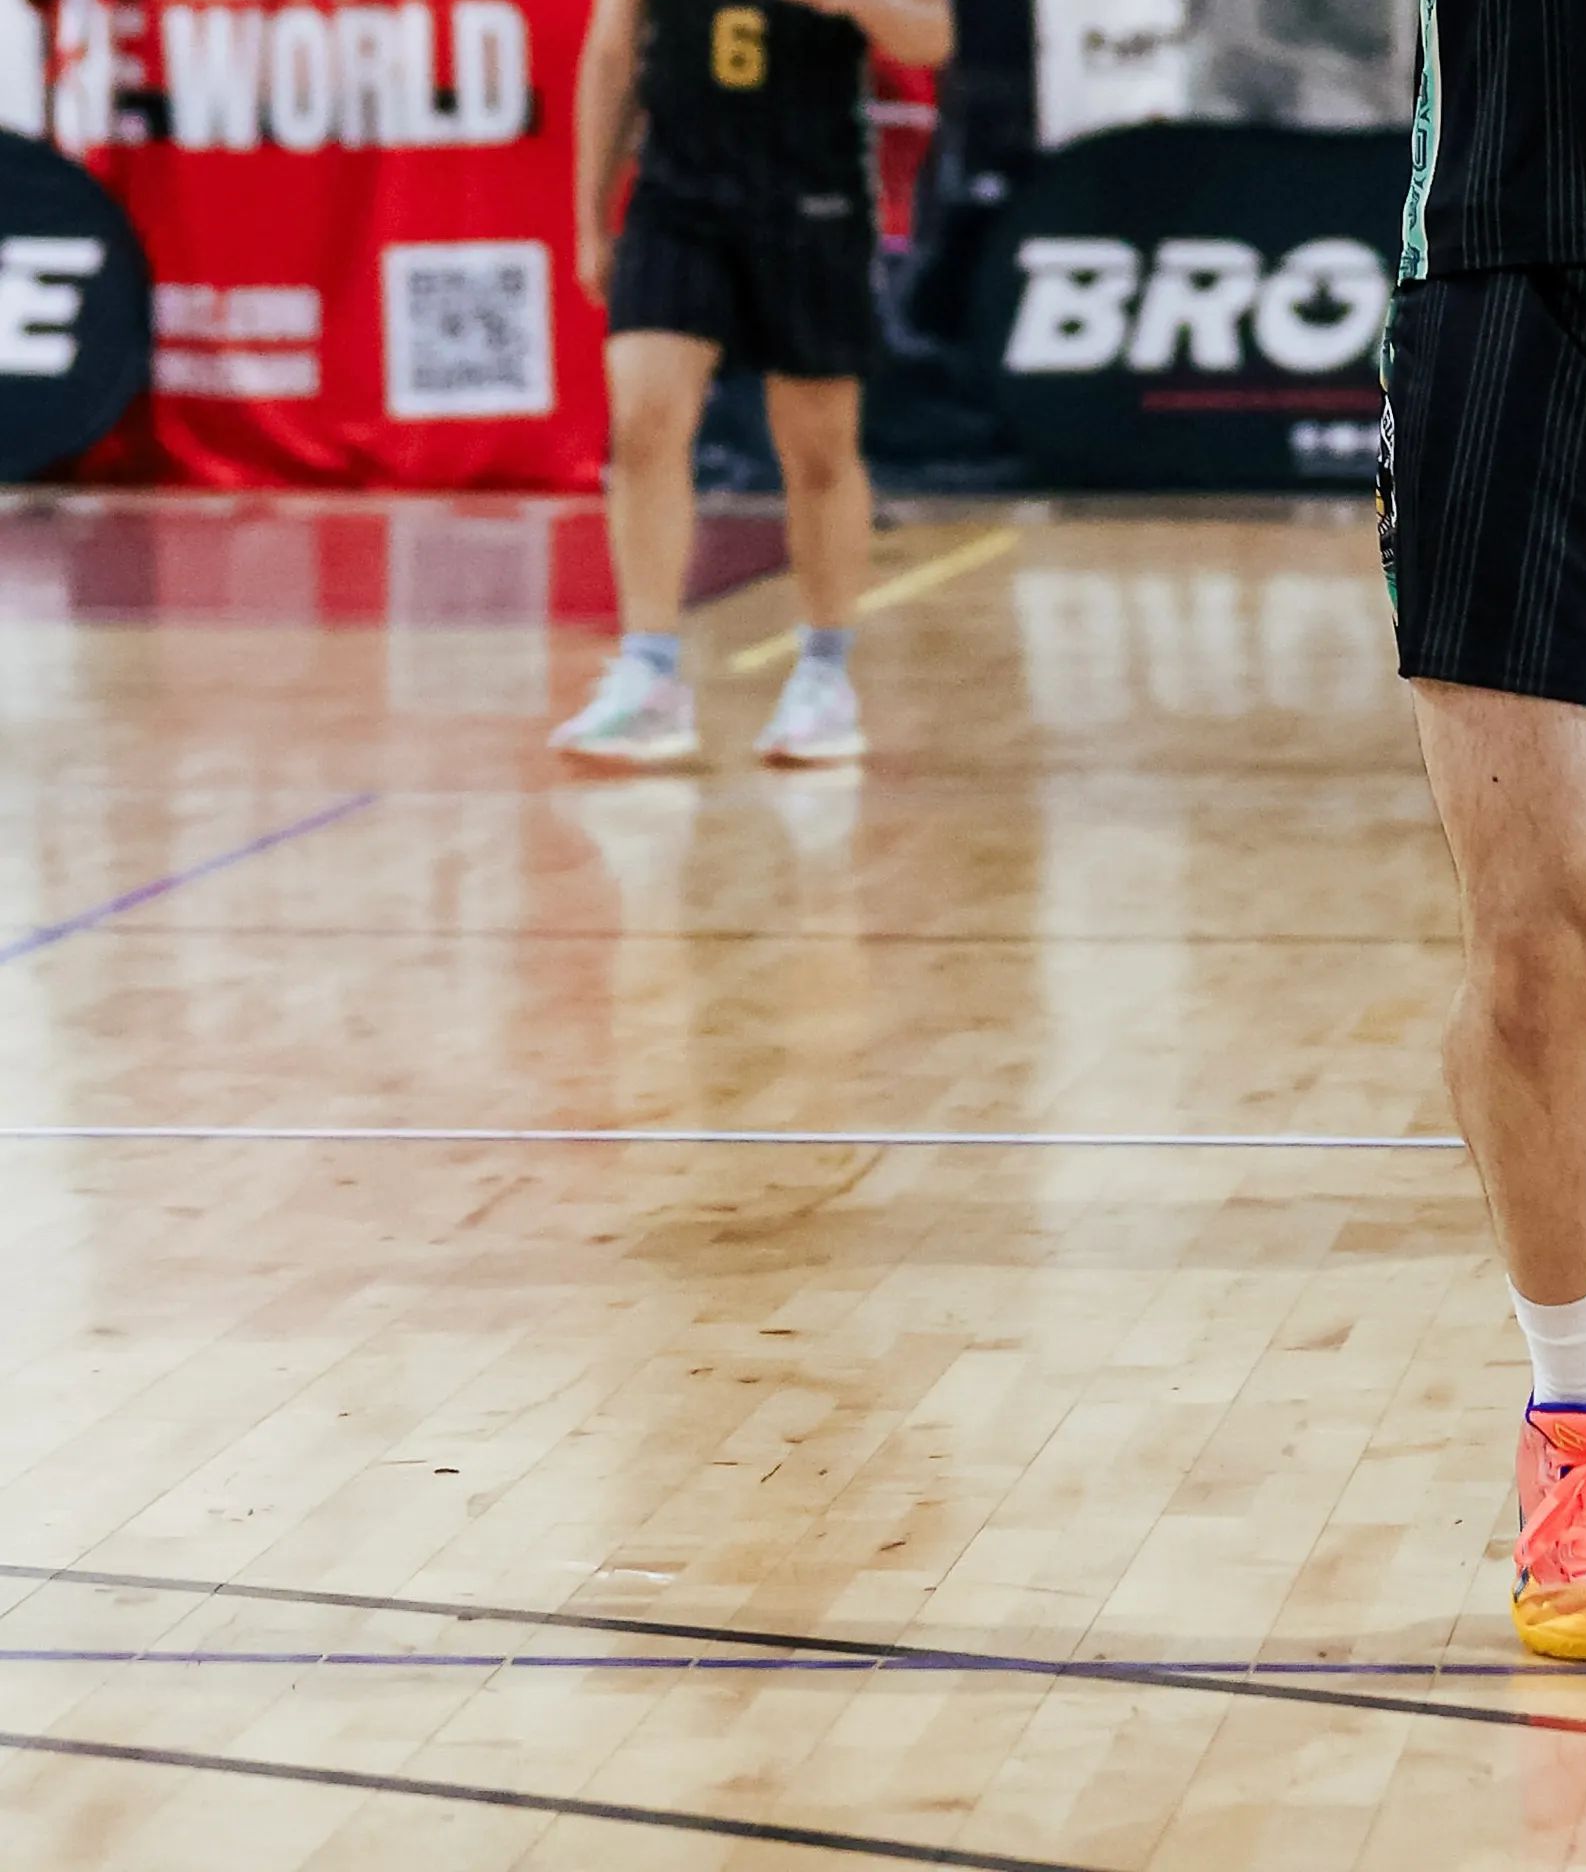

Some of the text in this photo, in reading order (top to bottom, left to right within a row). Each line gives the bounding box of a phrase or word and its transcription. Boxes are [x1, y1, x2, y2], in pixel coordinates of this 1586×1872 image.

[162, 0, 530, 151] WORLD
[712, 6, 767, 90] 6
[0, 235, 105, 376] E
[1002, 236, 1389, 376] BRO
